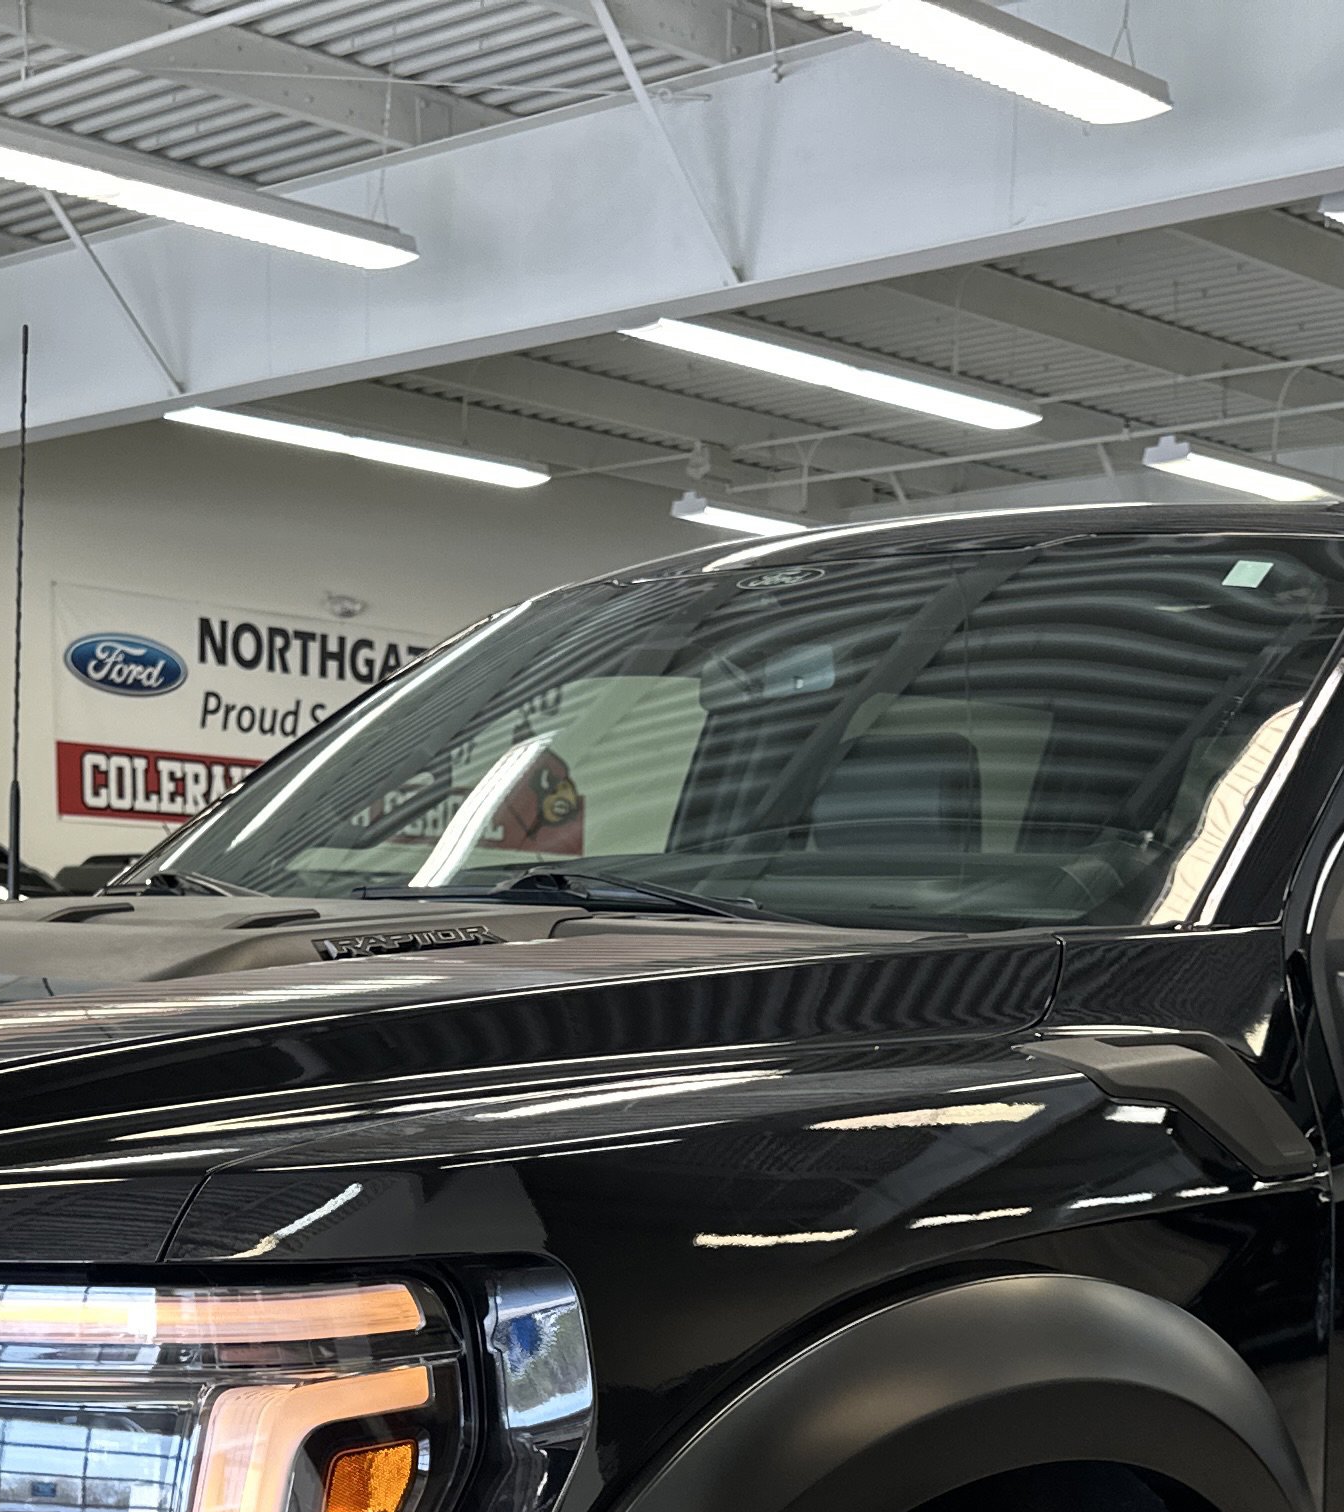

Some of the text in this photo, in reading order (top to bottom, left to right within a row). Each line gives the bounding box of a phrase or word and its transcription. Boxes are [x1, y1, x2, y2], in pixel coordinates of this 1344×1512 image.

[86, 641, 166, 688] Ford
[200, 691, 301, 738] Proud
[81, 751, 253, 816] COLERA
[324, 925, 504, 960] RAPTOR
